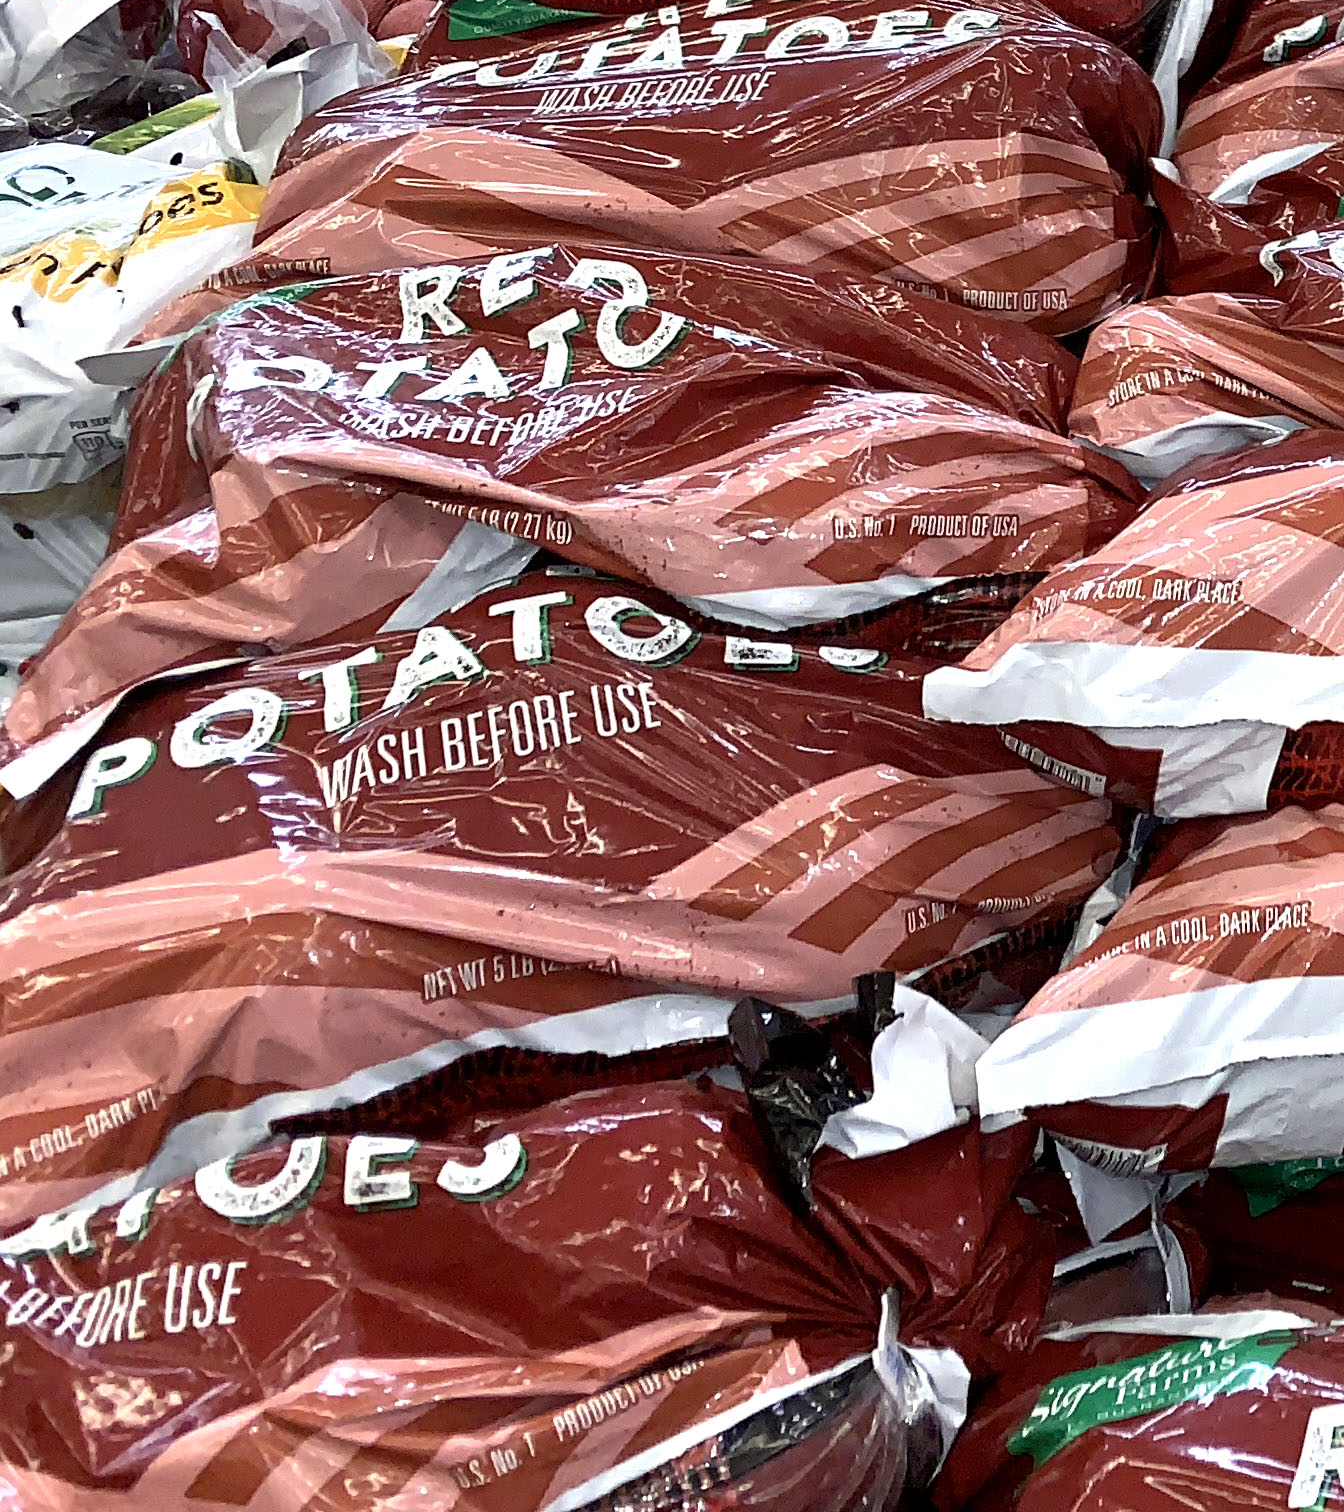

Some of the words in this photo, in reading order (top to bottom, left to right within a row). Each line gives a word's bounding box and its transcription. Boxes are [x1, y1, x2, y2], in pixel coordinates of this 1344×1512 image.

[536, 82, 614, 116] WASH
[612, 77, 719, 110] BEFORE
[718, 69, 778, 104] USE
[962, 288, 1020, 311] PRODUCT
[1022, 290, 1039, 311] OF
[1041, 288, 1069, 311] USA
[543, 518, 573, 546] kg)
[834, 517, 862, 540] U.S.
[862, 515, 884, 538] No.
[888, 515, 897, 537] 1
[908, 515, 971, 538] PRODUCT
[970, 515, 990, 538] OF
[992, 515, 1019, 538] USA
[1108, 578, 1149, 601] COOL,
[1153, 578, 1195, 602] DARK
[1196, 578, 1240, 605] PLACE
[319, 724, 427, 807] WASH
[439, 694, 585, 777] BEFORE
[590, 681, 664, 738] USE
[904, 906, 933, 934] U.S.
[1133, 930, 1154, 951] IN
[1154, 927, 1170, 948] A
[1171, 920, 1215, 947] COOL,
[1219, 913, 1262, 940] DARK
[1264, 901, 1312, 931] PLACE
[422, 966, 456, 1001] NET
[454, 957, 487, 990] WT
[491, 954, 506, 982] 5
[12, 1144, 27, 1169] A
[25, 1124, 84, 1164] COOL,
[84, 1097, 138, 1140] DARK
[6, 1272, 149, 1349] BEFORE
[163, 1262, 249, 1335] USE
[1112, 1351, 1237, 1406] Farms
[489, 1448, 524, 1478] No.
[522, 1431, 537, 1458] 1
[552, 1386, 637, 1443] PRODUCT
